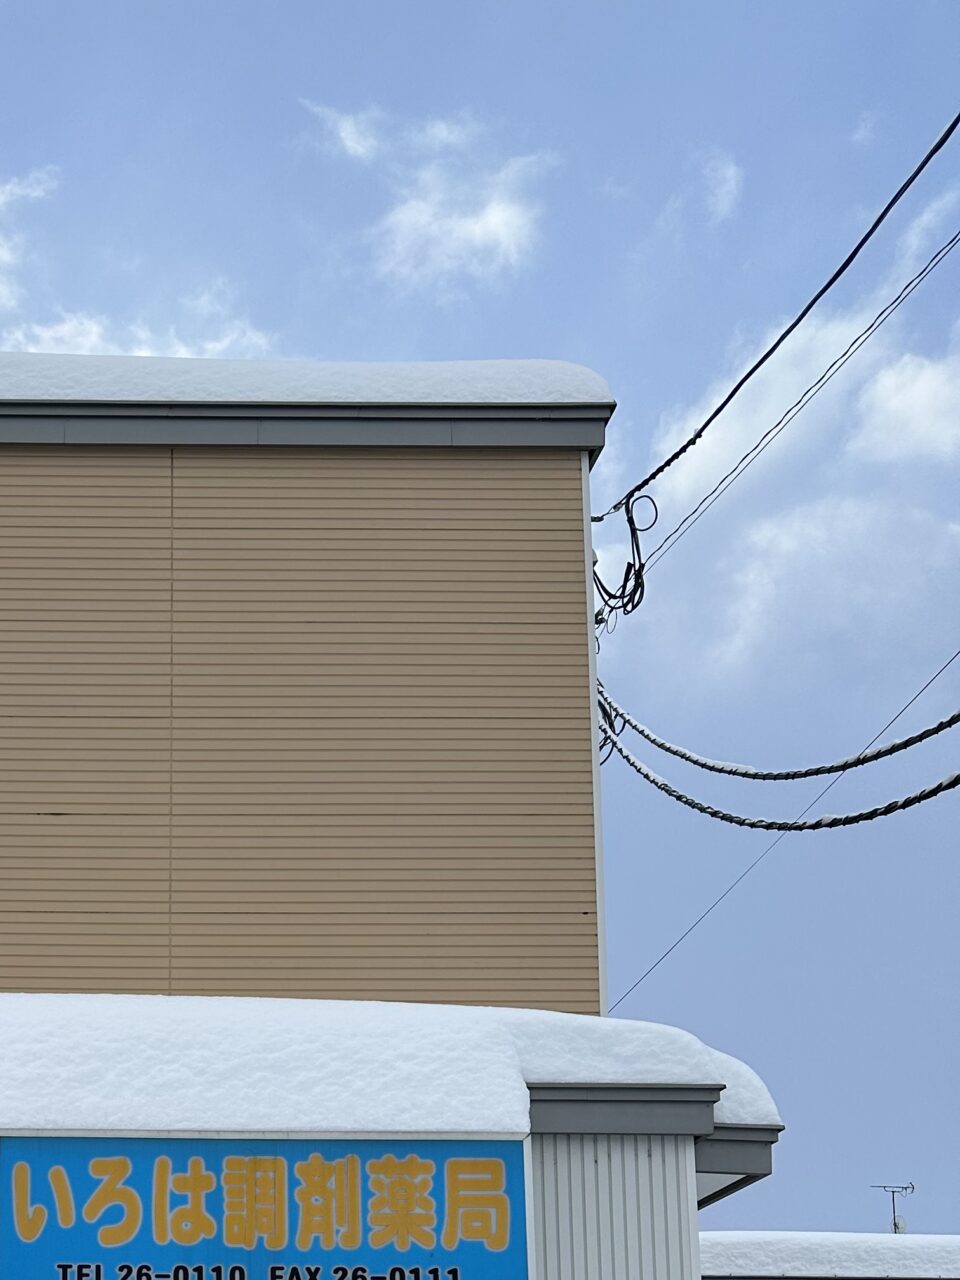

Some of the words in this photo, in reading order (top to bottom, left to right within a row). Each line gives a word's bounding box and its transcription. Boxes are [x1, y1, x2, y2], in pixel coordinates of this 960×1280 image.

[12, 1153, 511, 1252] いろは調剤薬局
